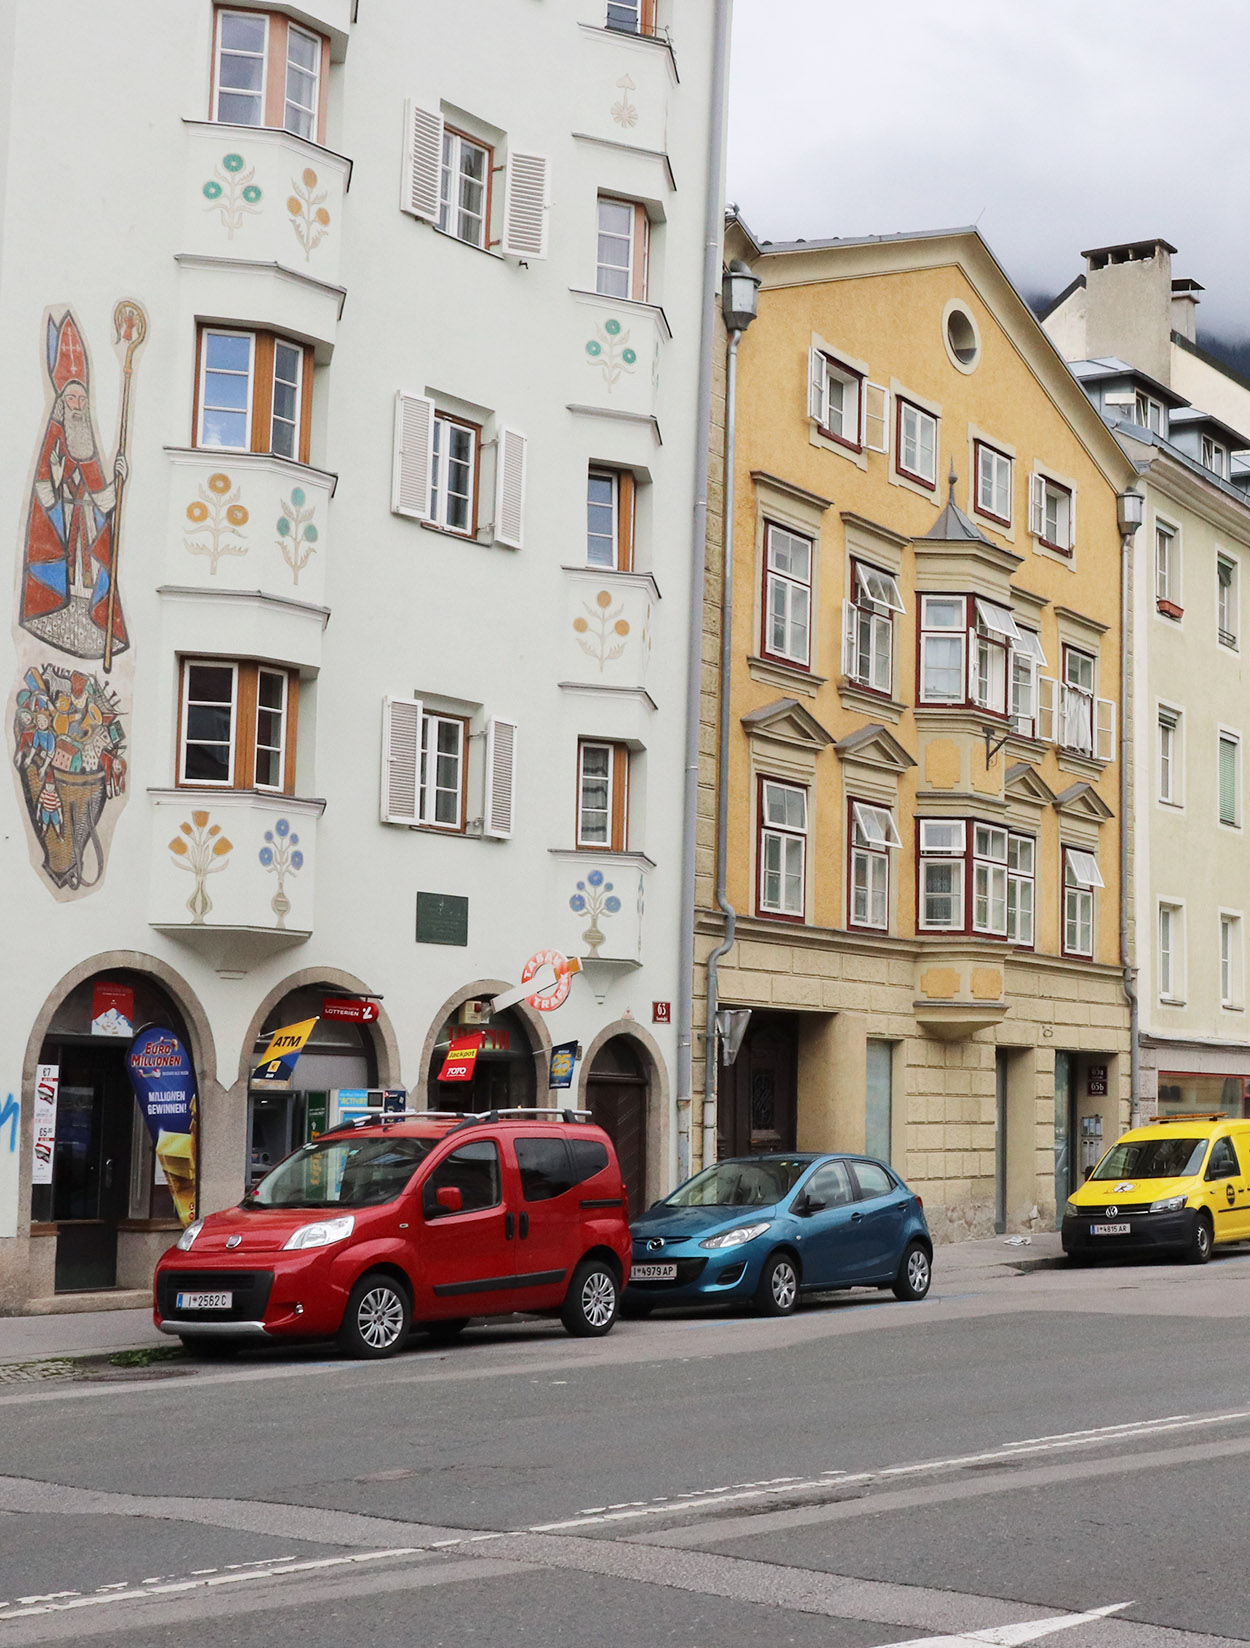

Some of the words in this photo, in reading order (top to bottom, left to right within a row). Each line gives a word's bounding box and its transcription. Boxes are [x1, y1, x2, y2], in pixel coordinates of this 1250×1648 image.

[523, 951, 564, 979] TABAK
[533, 973, 570, 1009] TRAFIK
[324, 1008, 360, 1017] LOTTERIEN
[657, 1003, 667, 1016] 63
[272, 1035, 302, 1048] ATM
[145, 1042, 172, 1056] EURO
[449, 1050, 475, 1059] Jackpot
[131, 1053, 181, 1068] MILLIONEN
[447, 1066, 467, 1075] TOTO
[1090, 1081, 1105, 1091] 65b
[148, 1090, 186, 1102] MILLIONEN
[147, 1103, 187, 1115] GEWINNEN!
[1103, 1225, 1118, 1233] 4815
[1118, 1224, 1127, 1232] AR
[642, 1266, 662, 1277] 4979
[662, 1266, 674, 1276] AP
[198, 1295, 220, 1307] 2562
[221, 1295, 227, 1306] C
